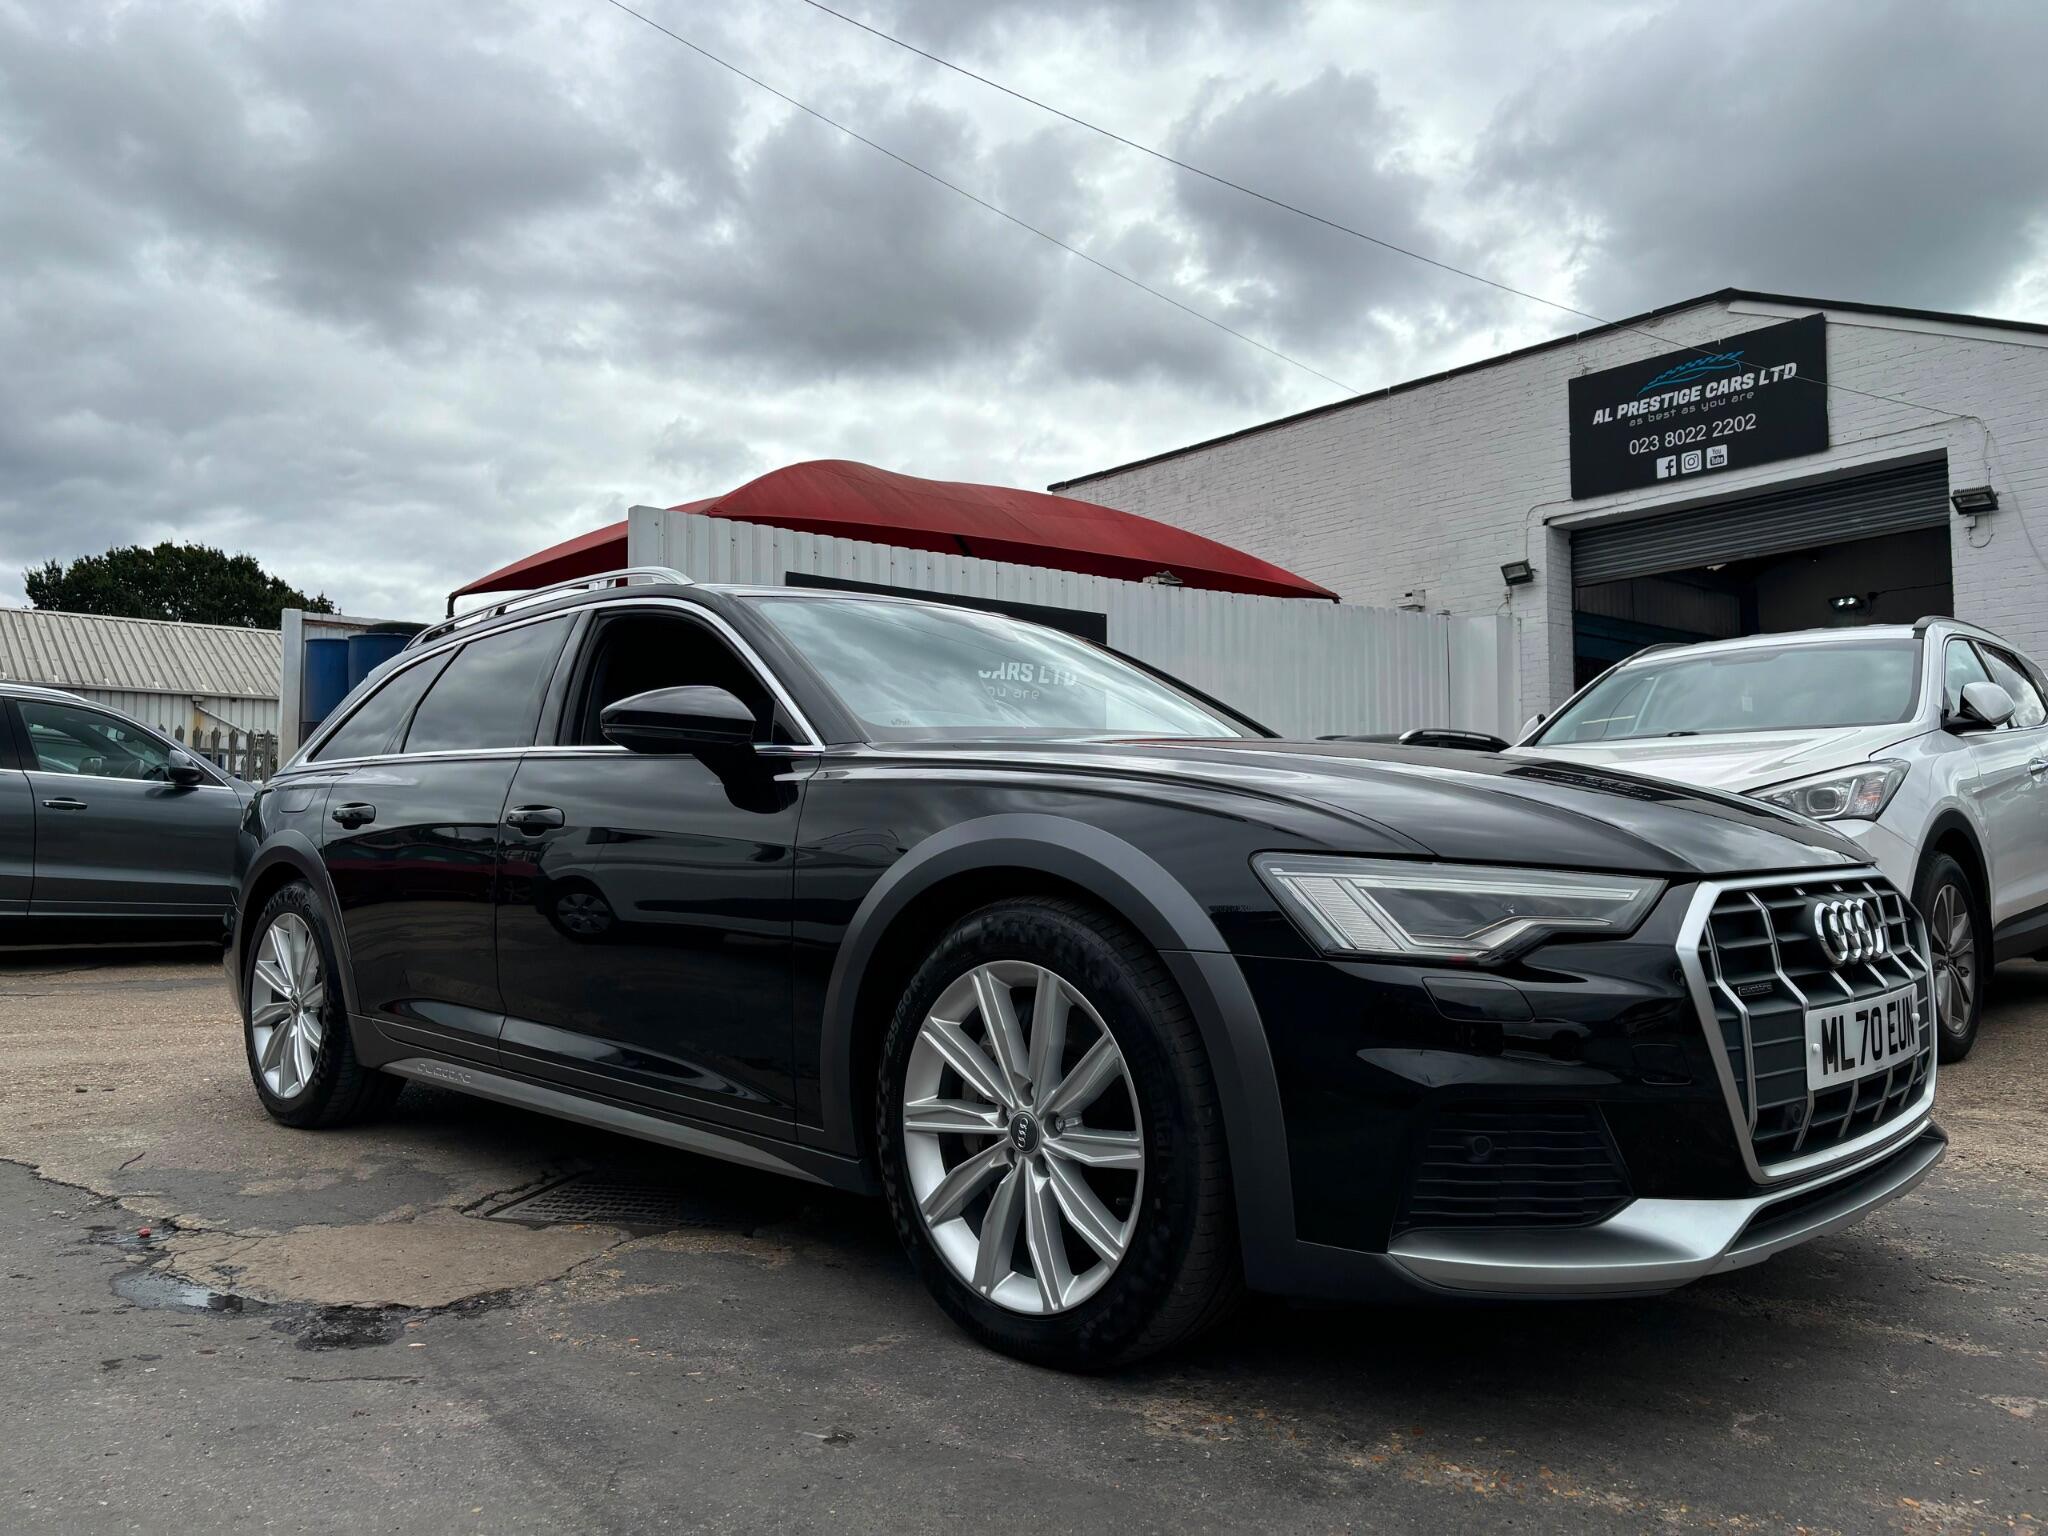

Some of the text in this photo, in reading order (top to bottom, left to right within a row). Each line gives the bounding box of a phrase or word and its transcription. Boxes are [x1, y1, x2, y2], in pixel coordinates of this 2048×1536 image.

[1592, 362, 1797, 425] AL PRESTIGE CARS LTD
[1629, 391, 1755, 427] as best as you are
[1629, 413, 1757, 455] 023 8022 2202
[986, 685, 1040, 699] ou are
[1887, 995, 1915, 1056] EUN
